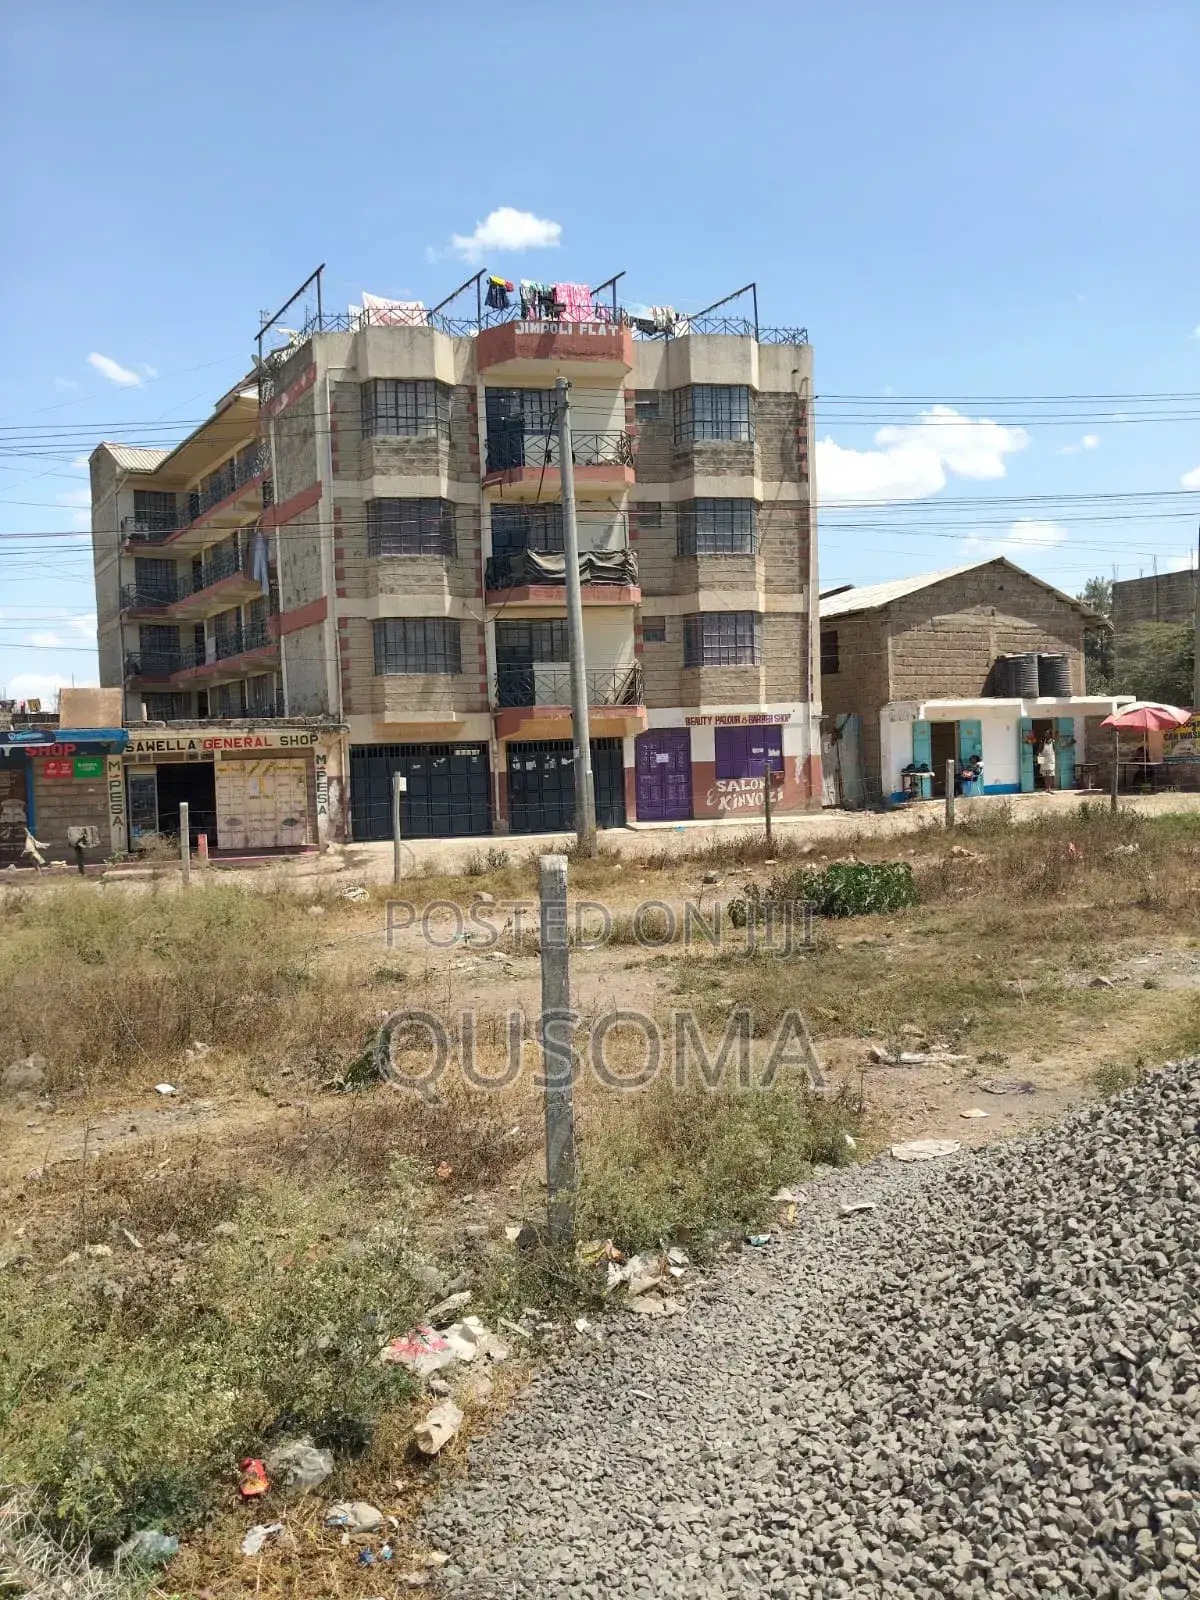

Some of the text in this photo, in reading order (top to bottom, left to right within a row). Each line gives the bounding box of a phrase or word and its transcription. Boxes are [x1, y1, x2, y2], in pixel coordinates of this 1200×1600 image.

[515, 321, 619, 336] JIMPOLI FLAT
[685, 716, 713, 726] BEAUTY
[774, 713, 792, 723] SHOP
[24, 741, 77, 757] SHOP
[126, 735, 319, 752] SAWELLA GENERAL SHOP
[716, 779, 767, 793] SALON
